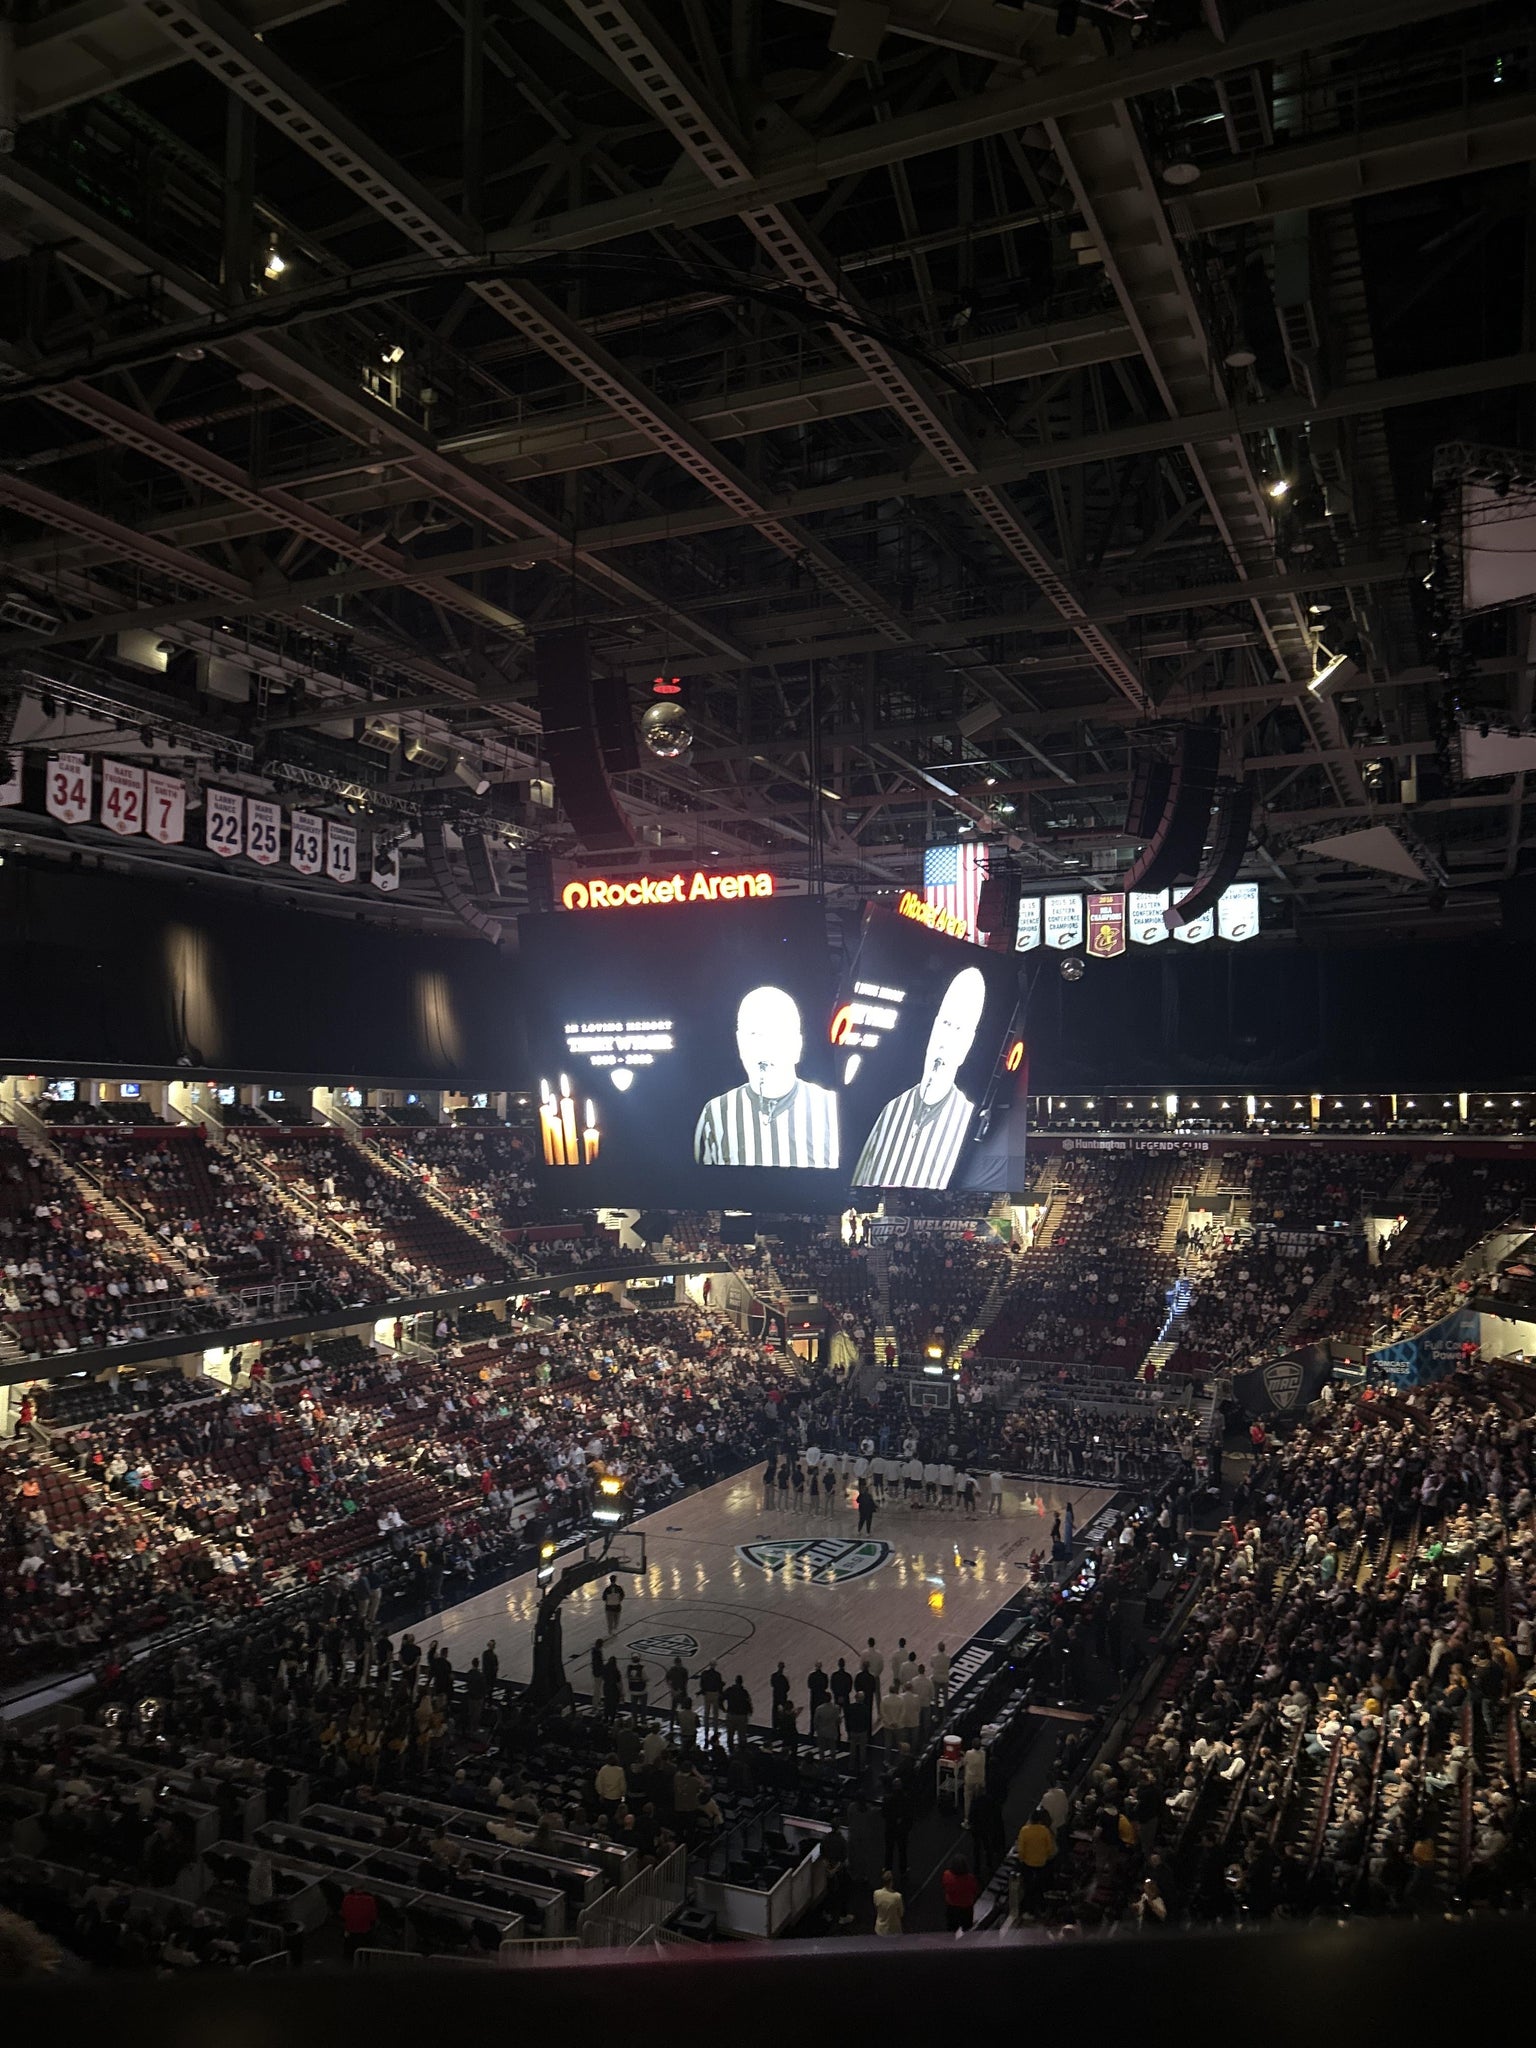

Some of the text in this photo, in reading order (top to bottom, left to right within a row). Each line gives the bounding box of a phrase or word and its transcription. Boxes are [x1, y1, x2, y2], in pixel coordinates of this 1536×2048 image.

[53, 773, 86, 810] 34
[107, 787, 138, 822] 42
[159, 798, 172, 829] 7
[211, 812, 238, 845] 22
[251, 822, 276, 853] 25
[294, 833, 318, 863] 43
[333, 844, 351, 871] 11
[588, 871, 773, 908] Rocket Arena
[1090, 913, 1122, 922] CHAMPIONS
[1075, 1138, 1126, 1152] Huntington
[1135, 1141, 1180, 1151] LEGENDS
[913, 1219, 978, 1231] WELCOME
[1424, 1340, 1444, 1350] Full
[1269, 1377, 1299, 1391] MAC
